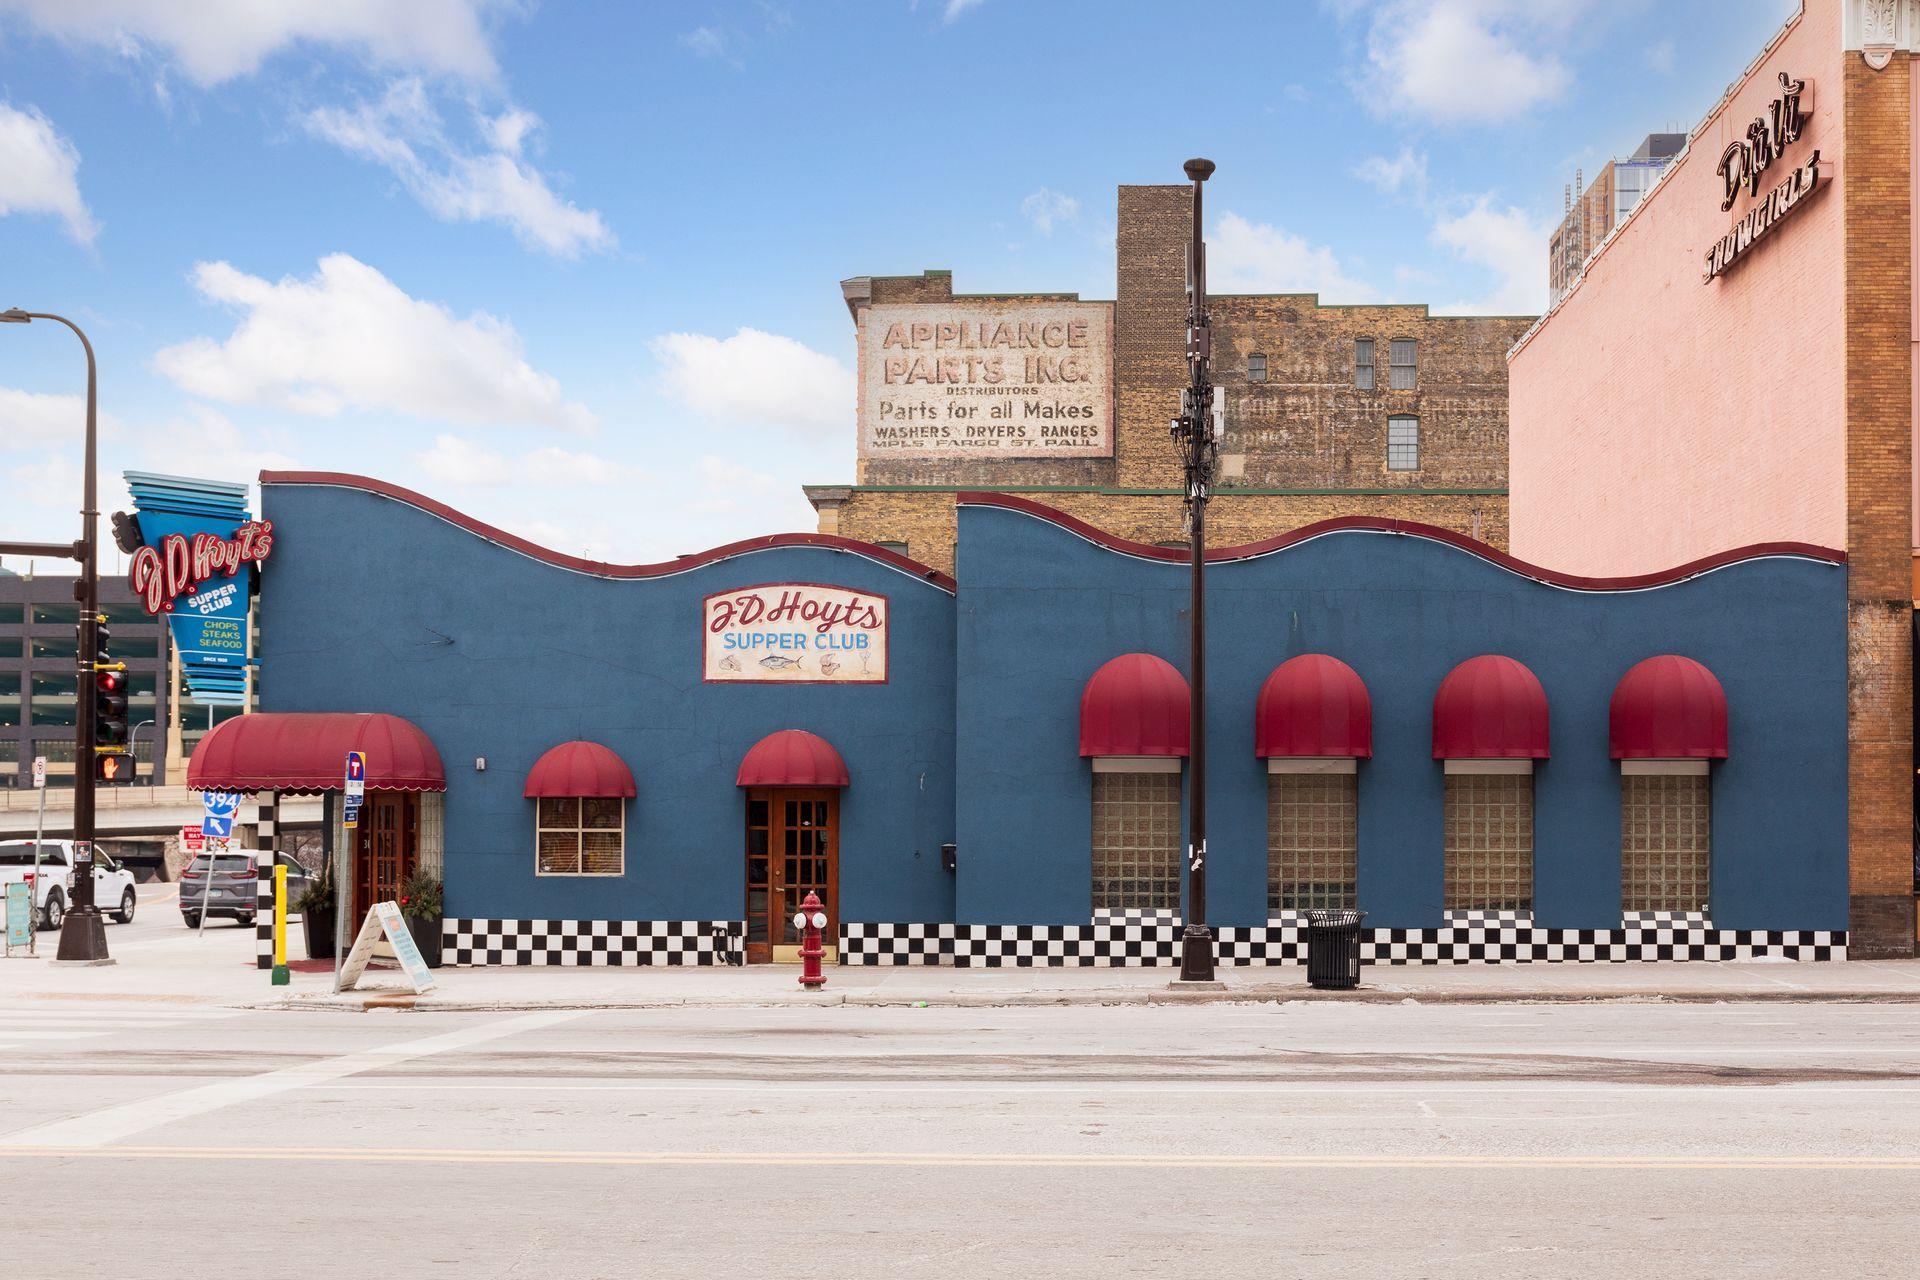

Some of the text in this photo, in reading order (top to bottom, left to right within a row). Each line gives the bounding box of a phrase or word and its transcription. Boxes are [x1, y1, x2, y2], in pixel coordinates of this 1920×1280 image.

[1703, 150, 1820, 285] SHOWGIRLS
[883, 319, 1088, 350] APPLIANCE
[884, 355, 1005, 384] PARTS
[946, 386, 1039, 396] DISTRIBUTORS
[879, 401, 1094, 420] Parts for all Makes
[874, 425, 1098, 438] WASHERS DRYERS RANGES
[872, 439, 924, 448] MPLS
[936, 439, 1000, 447] FARGO
[191, 520, 275, 579] Hoyt's
[187, 583, 237, 608] SUPPER
[200, 596, 233, 615] CLUB
[202, 629, 240, 640] STEAKS
[204, 620, 239, 631] CHOPS
[200, 638, 242, 649] SEAFOOD
[723, 632, 869, 650] SUPPER CLUB
[205, 792, 237, 809] 394
